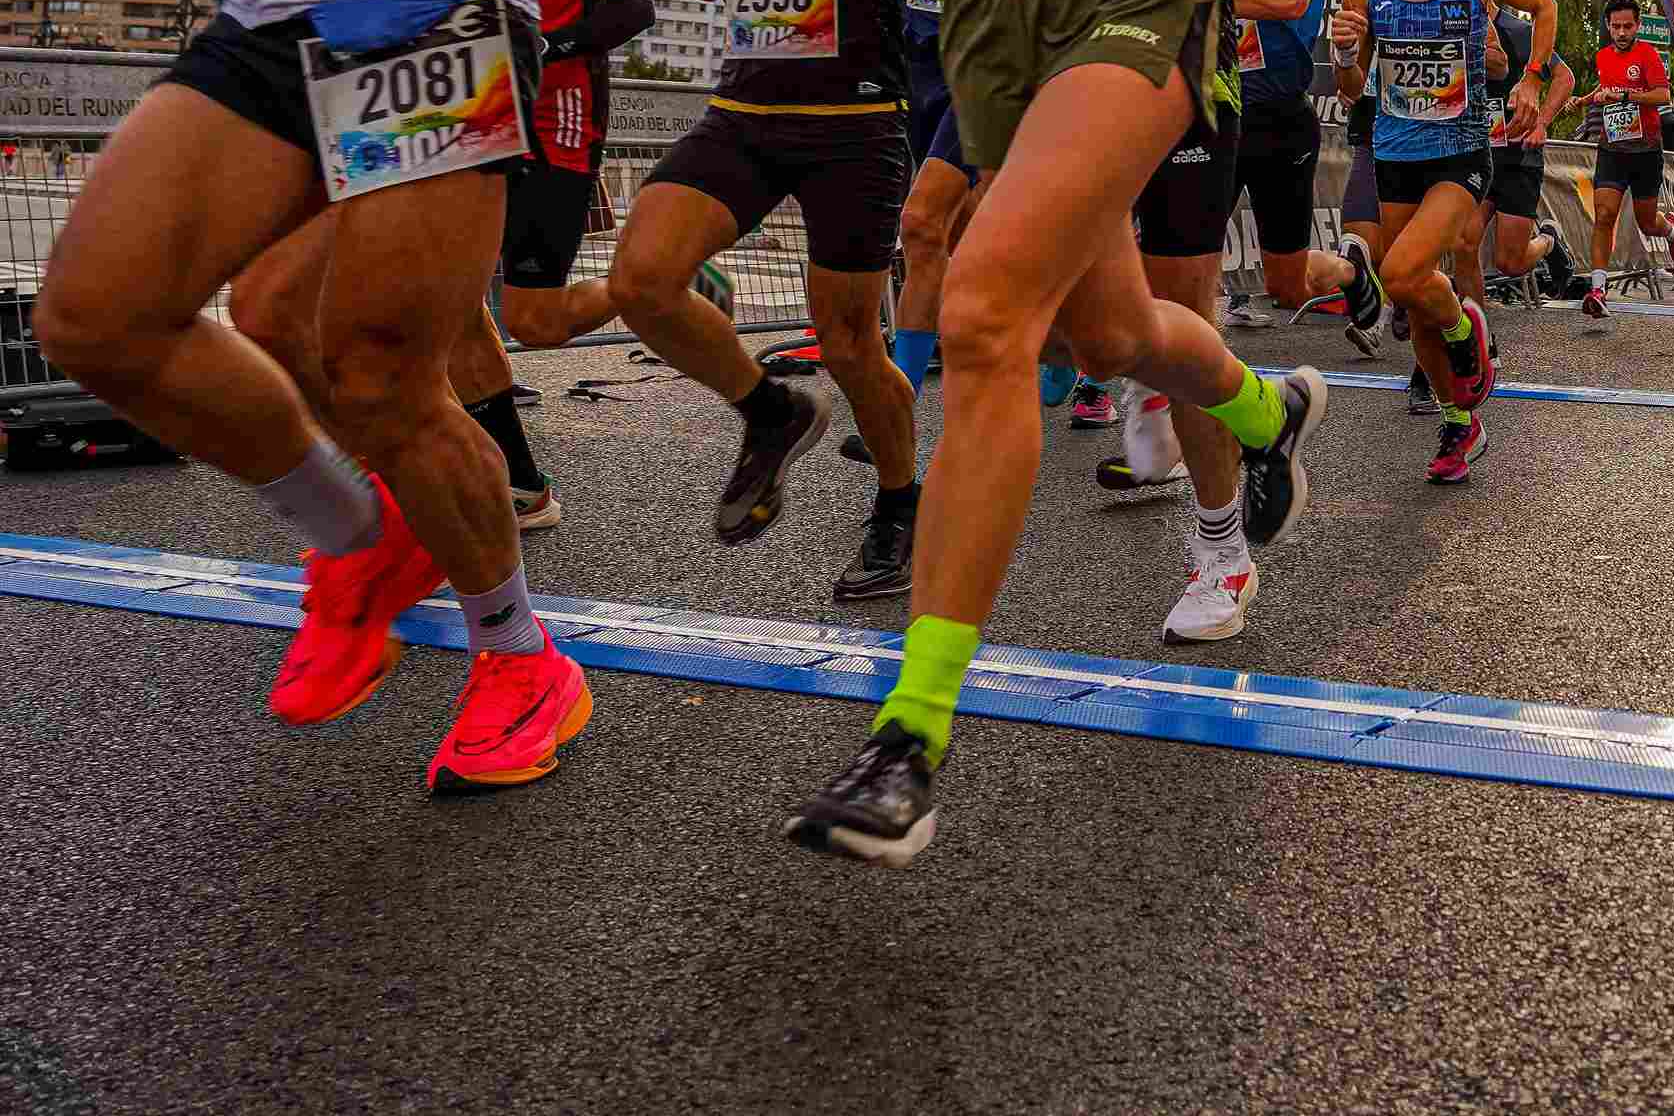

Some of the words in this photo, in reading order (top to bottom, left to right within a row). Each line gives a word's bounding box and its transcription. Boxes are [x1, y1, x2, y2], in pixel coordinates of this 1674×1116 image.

[1101, 22, 1162, 46] TERREX
[354, 46, 478, 125] 2081
[1393, 62, 1451, 88] 2255
[37, 97, 76, 117] DEL
[1171, 149, 1212, 165] adidas
